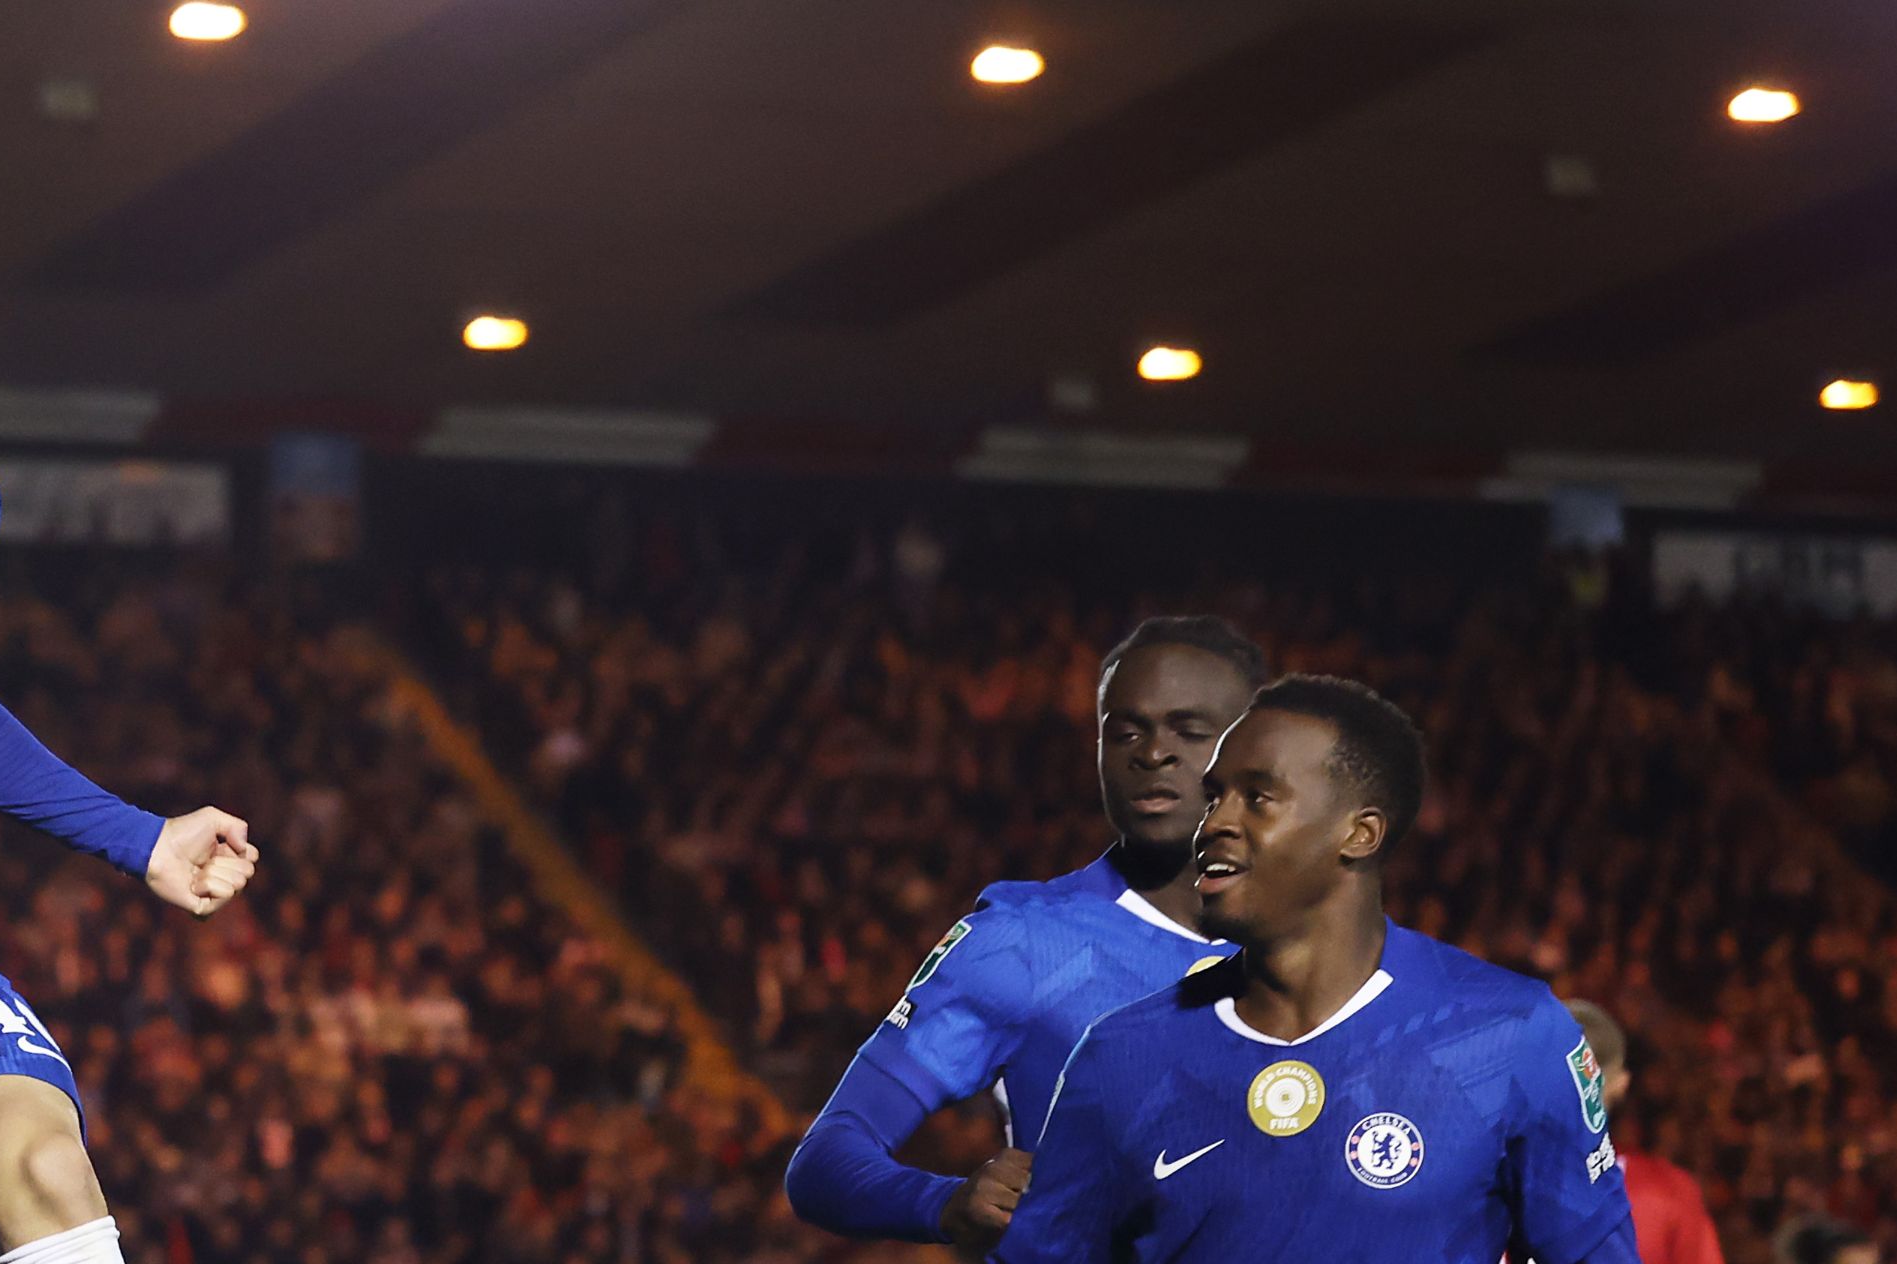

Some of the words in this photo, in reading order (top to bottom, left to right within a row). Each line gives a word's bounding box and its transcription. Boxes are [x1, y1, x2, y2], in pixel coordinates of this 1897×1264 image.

[1275, 1065, 1319, 1106] CHAMPIONS
[1269, 1116, 1300, 1130] FIFA
[1361, 1115, 1412, 1135] CHELSEA
